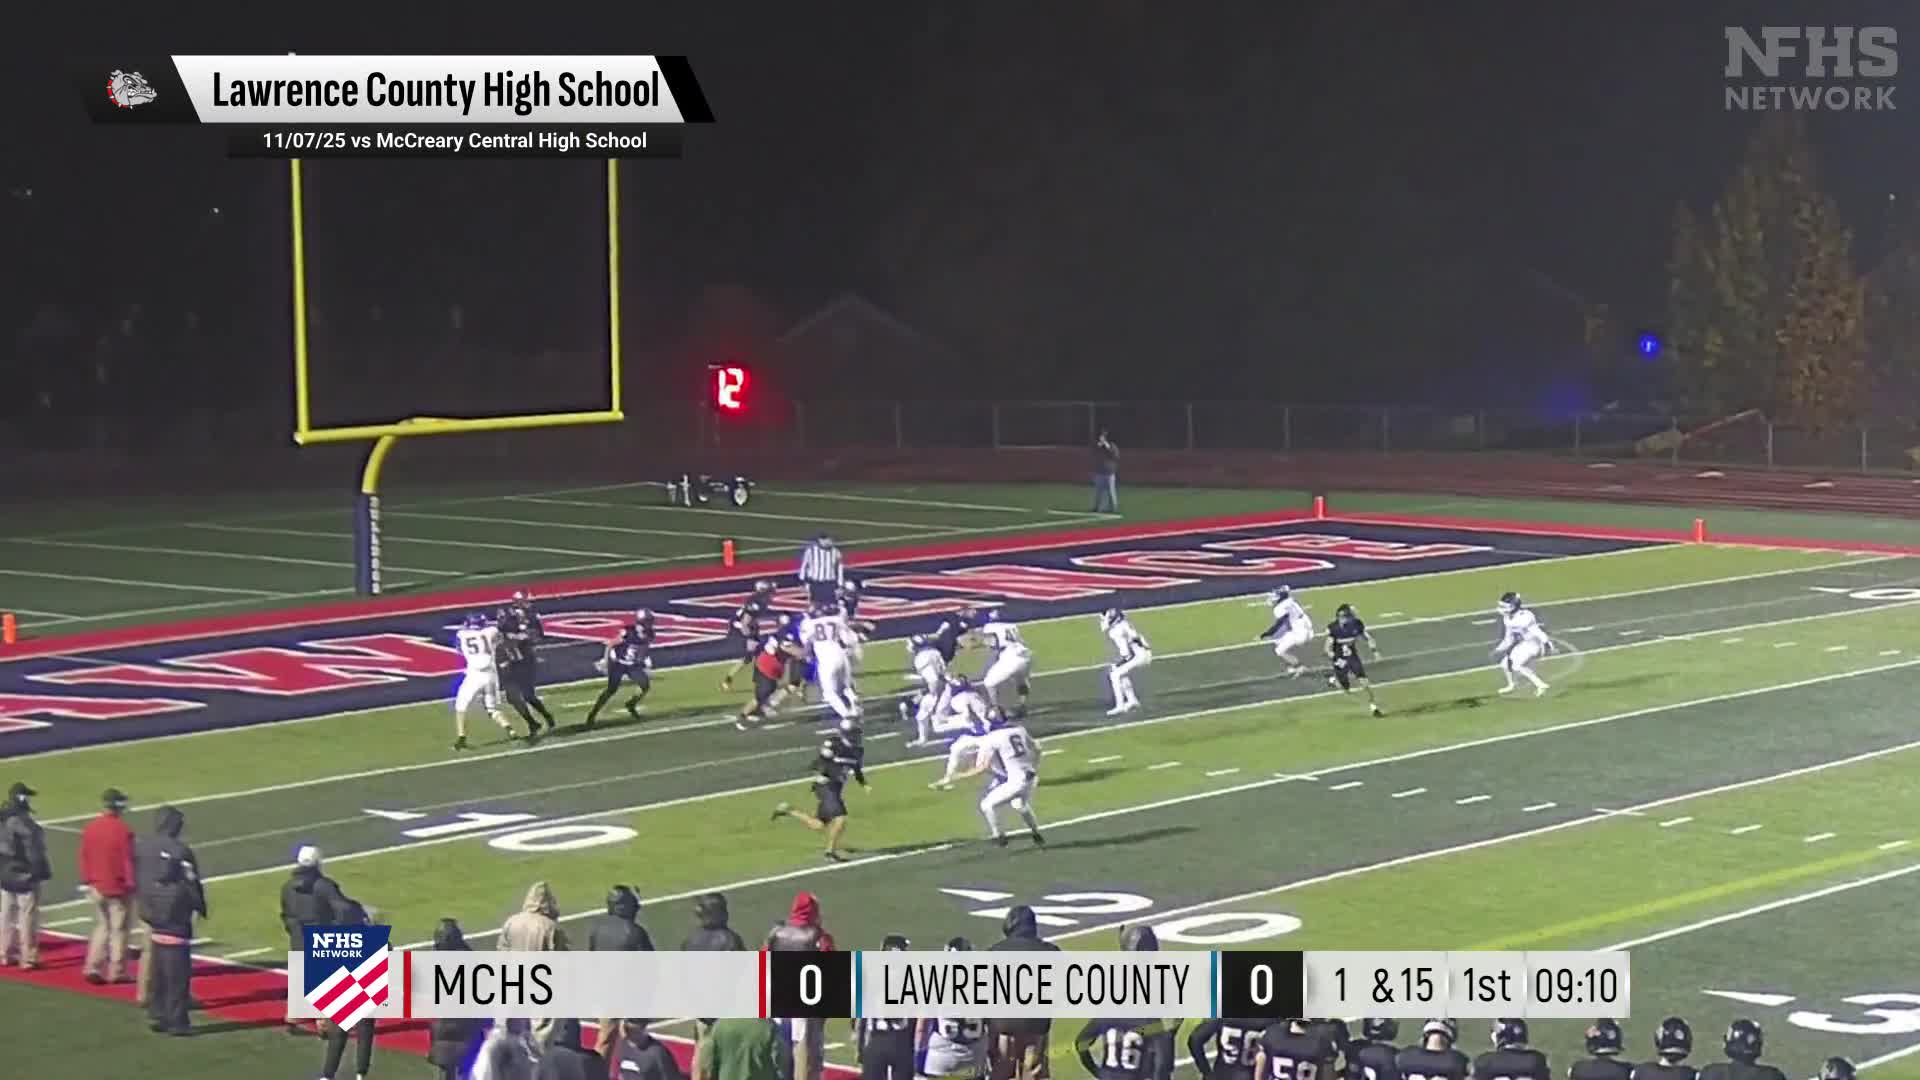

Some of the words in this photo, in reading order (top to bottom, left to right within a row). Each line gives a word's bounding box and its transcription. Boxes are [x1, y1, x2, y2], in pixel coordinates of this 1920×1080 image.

[717, 367, 745, 409] 12
[465, 633, 493, 656] 51
[814, 621, 839, 642] 87
[400, 811, 639, 852] 10
[968, 892, 1303, 944] 20
[1785, 992, 1920, 1035] 3
[1105, 1027, 1145, 1070] 16
